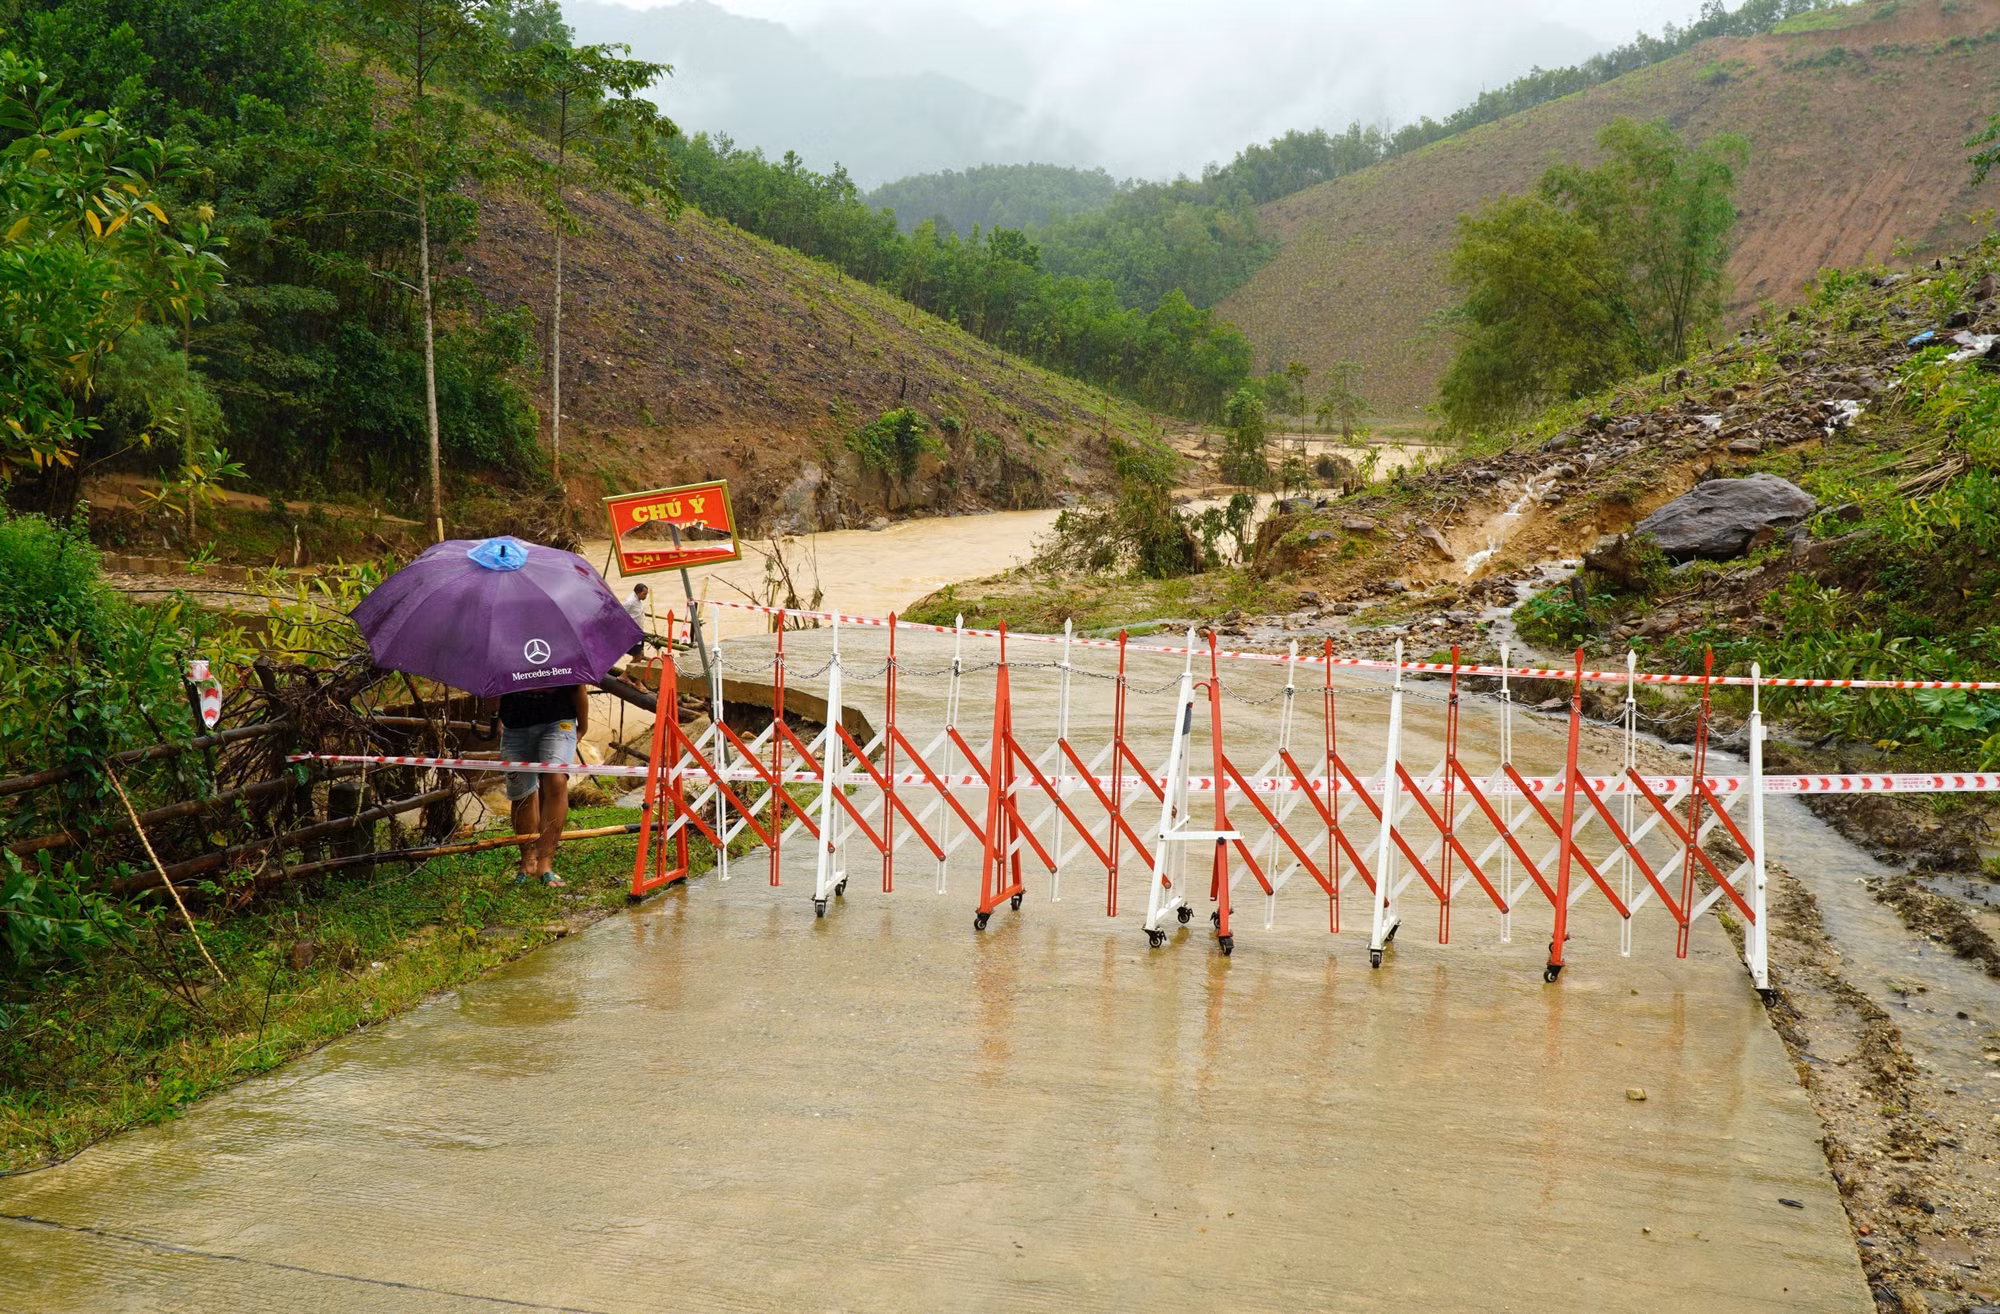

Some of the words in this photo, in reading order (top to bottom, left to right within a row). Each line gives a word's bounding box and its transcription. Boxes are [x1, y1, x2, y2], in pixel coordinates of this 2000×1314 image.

[632, 498, 682, 522] CHÚ
[689, 494, 705, 514] Ý
[512, 667, 572, 681] Mercedes-Benz
